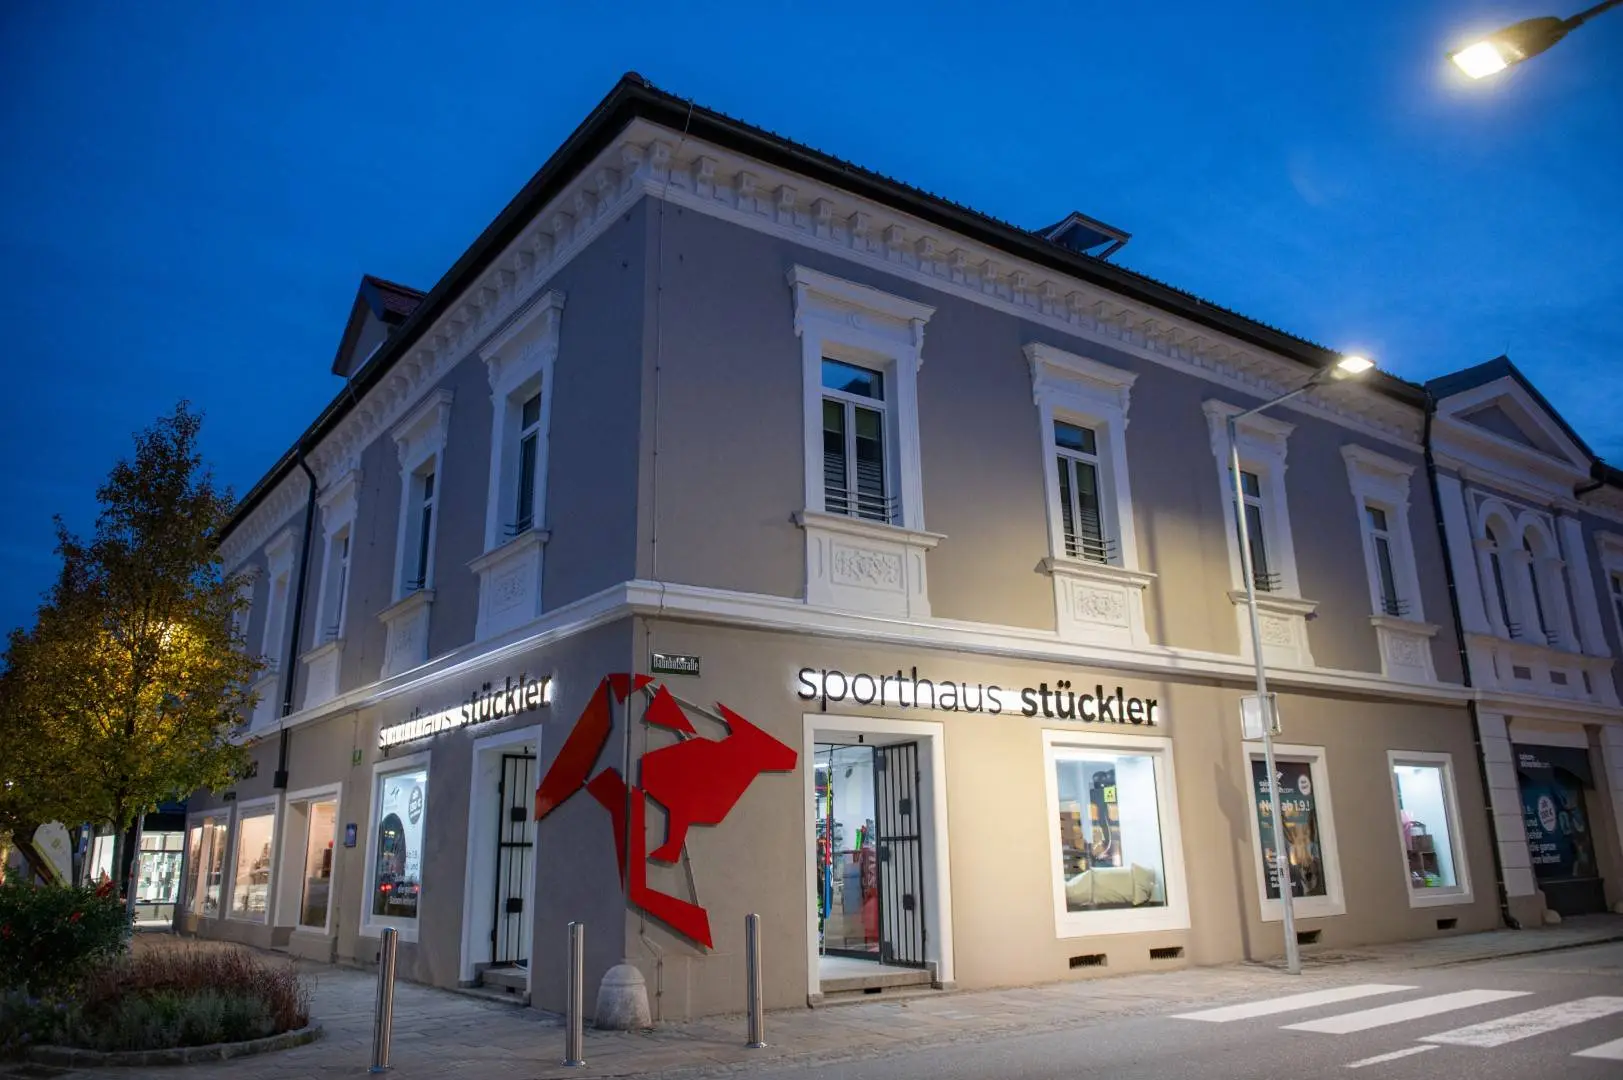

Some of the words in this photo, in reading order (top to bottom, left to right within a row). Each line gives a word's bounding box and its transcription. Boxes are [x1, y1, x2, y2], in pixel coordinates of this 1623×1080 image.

[378, 704, 452, 757] sporthaus
[460, 673, 552, 728] stückler
[797, 666, 1003, 715] sporthaus
[1020, 679, 1158, 726] stückler
